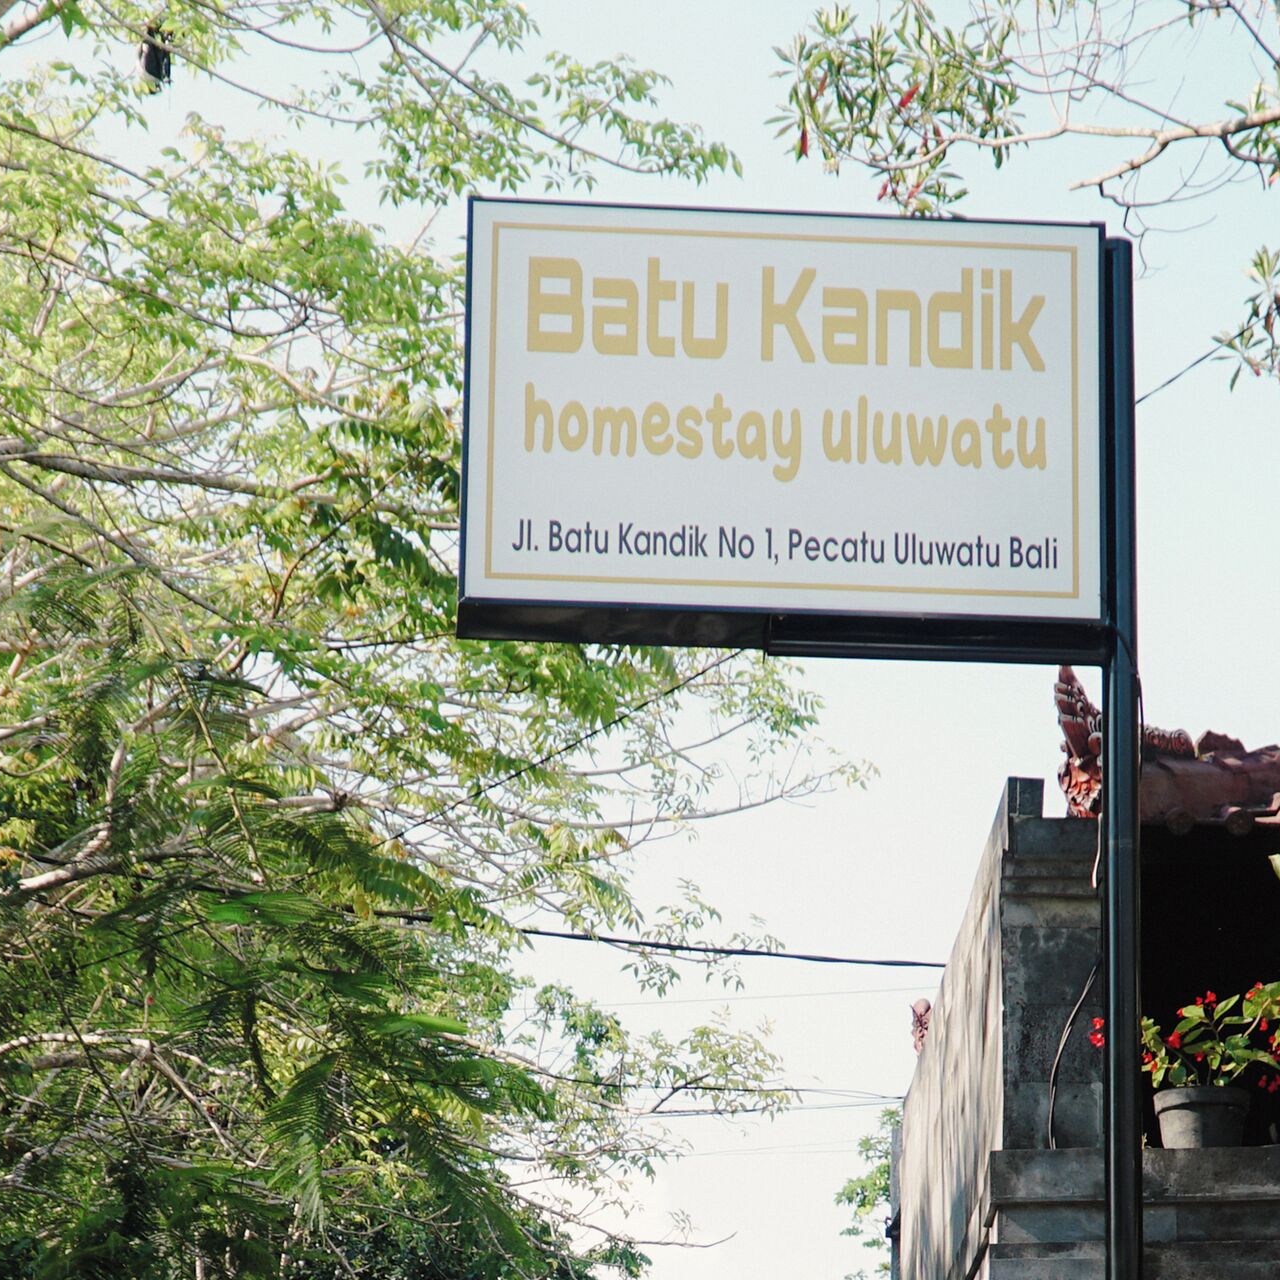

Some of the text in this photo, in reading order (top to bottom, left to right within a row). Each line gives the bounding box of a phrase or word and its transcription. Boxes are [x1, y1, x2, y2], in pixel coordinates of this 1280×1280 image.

[526, 256, 1046, 372] Batu Kandik
[524, 381, 1047, 482] homestay uluwatu
[512, 519, 1059, 570] Jl. Batu Kandik No 1, Pecatu Uluwatu Bali
